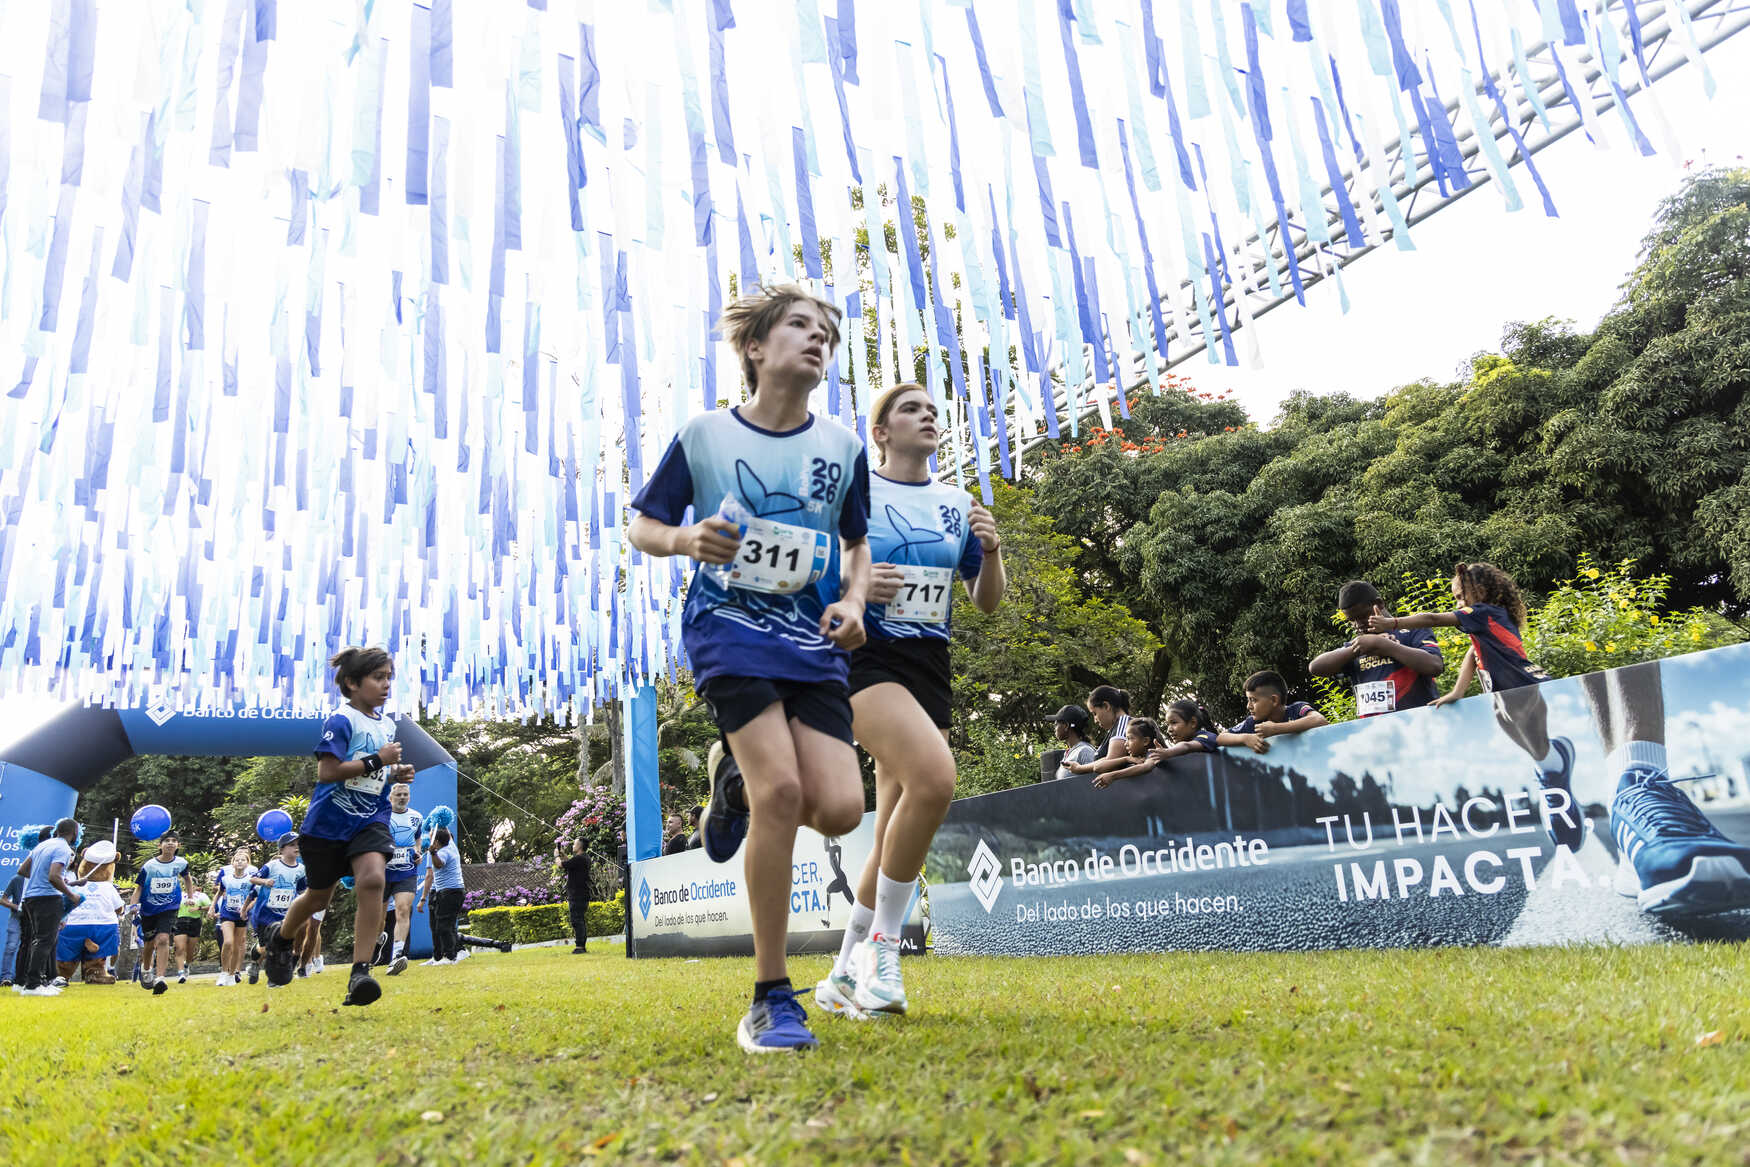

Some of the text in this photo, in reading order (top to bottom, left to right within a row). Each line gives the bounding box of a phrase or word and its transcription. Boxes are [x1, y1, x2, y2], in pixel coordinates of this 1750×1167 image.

[811, 457, 842, 484] 20
[810, 479, 838, 504] 26
[939, 504, 961, 522] 20
[943, 519, 962, 538] 26
[743, 539, 800, 572] 311
[904, 583, 946, 603] 717
[1360, 658, 1393, 671] SOCIAL
[1316, 787, 1595, 852] TU HACER,
[1011, 834, 1270, 887] Banco de Occidente
[1334, 843, 1613, 902] IMPACTA.
[791, 862, 823, 885] CER,
[654, 879, 736, 905] Banco de Occidente
[790, 889, 826, 913] CTA.
[654, 910, 729, 927] Del lado de los que hacen.
[1016, 892, 1244, 922] Del lado de los que hacen.
